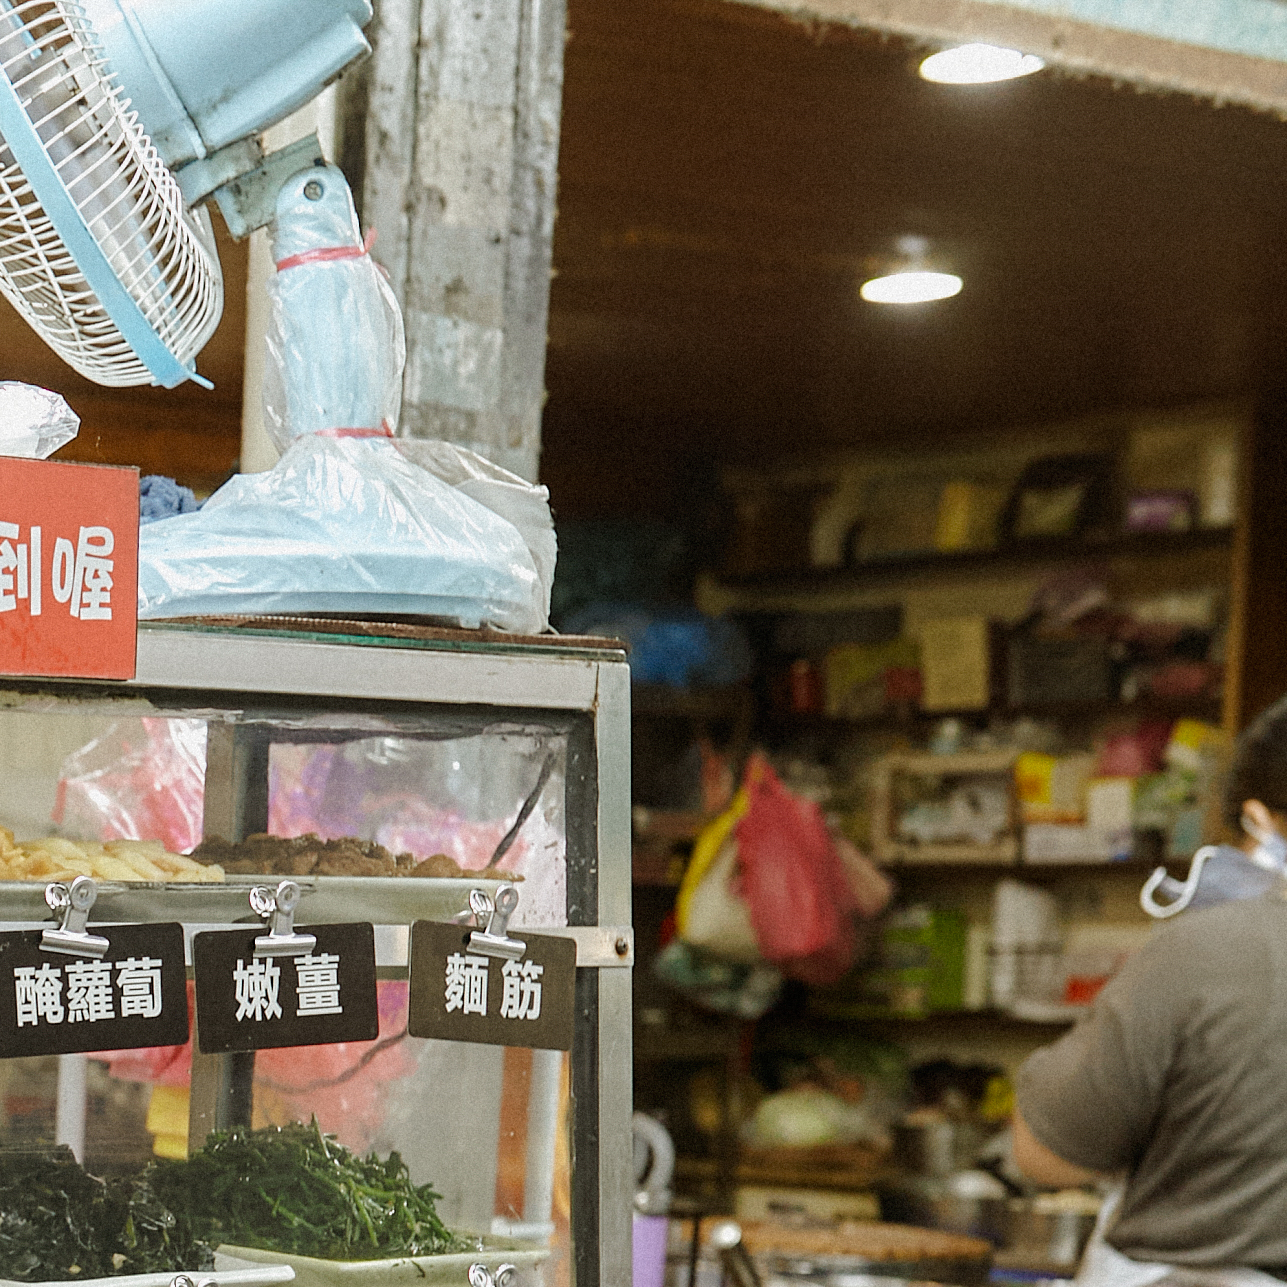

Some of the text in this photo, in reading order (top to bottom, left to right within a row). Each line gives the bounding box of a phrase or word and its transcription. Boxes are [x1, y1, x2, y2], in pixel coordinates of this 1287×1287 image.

[14, 957, 162, 1027] 醃蘿蔔
[233, 954, 343, 1023] 嫩薑
[445, 952, 543, 1020] 麵筋
